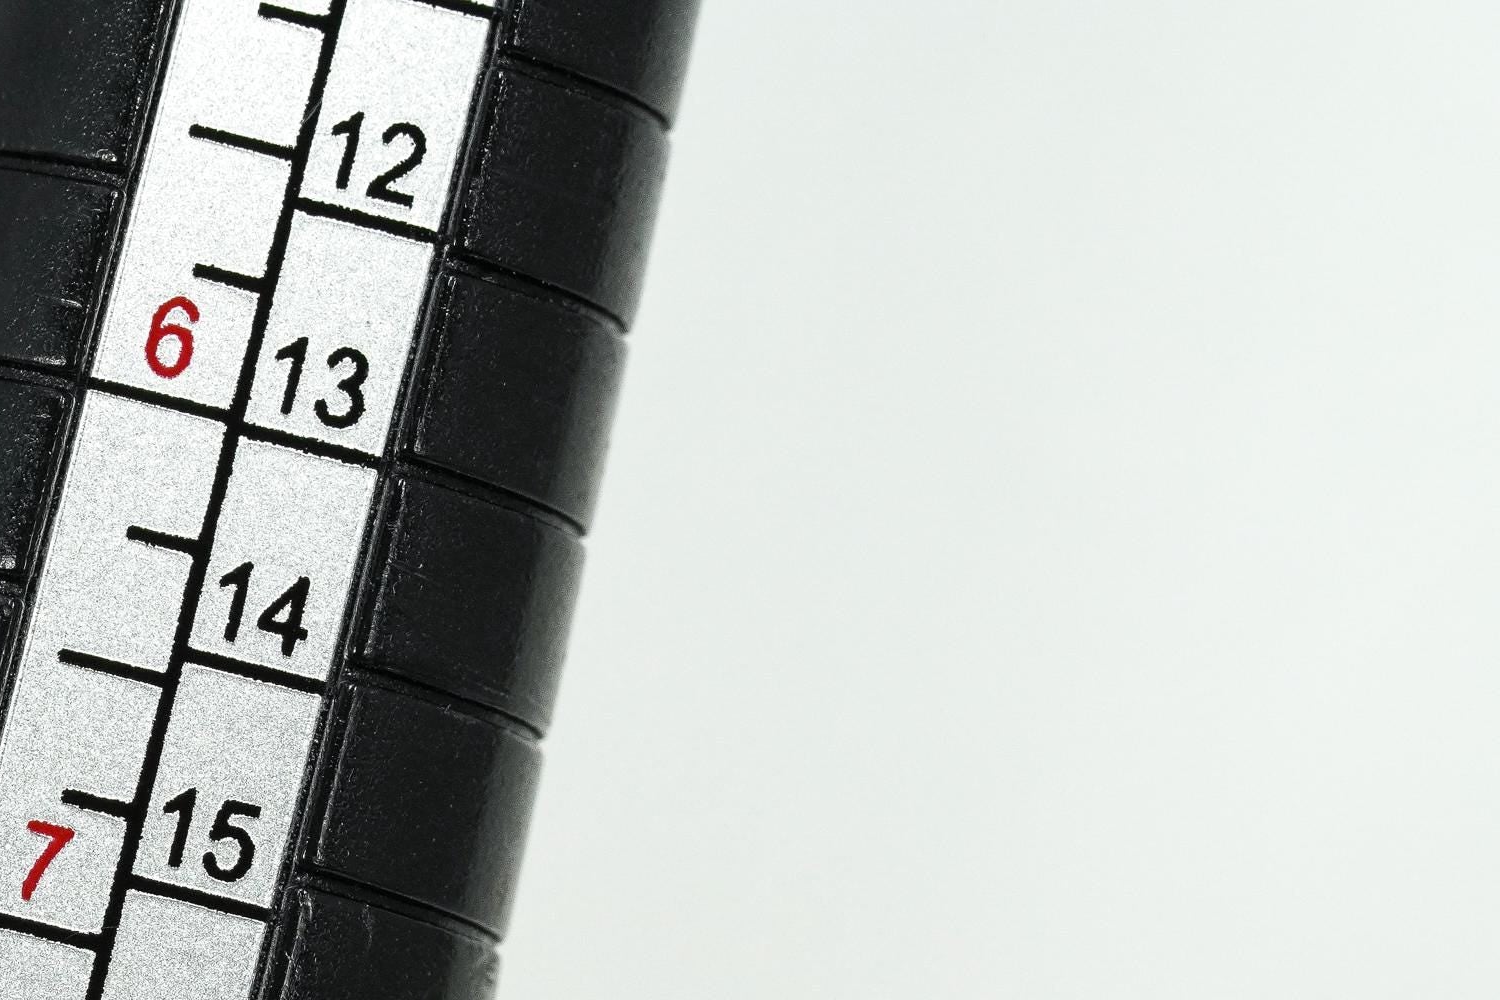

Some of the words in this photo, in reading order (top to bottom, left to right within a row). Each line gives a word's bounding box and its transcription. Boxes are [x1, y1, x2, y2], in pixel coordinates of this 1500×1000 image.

[331, 111, 427, 209] 12
[144, 295, 200, 379] 6
[274, 336, 369, 430] 13
[218, 561, 311, 658] 14
[21, 820, 75, 901] 7
[162, 786, 262, 883] 15
